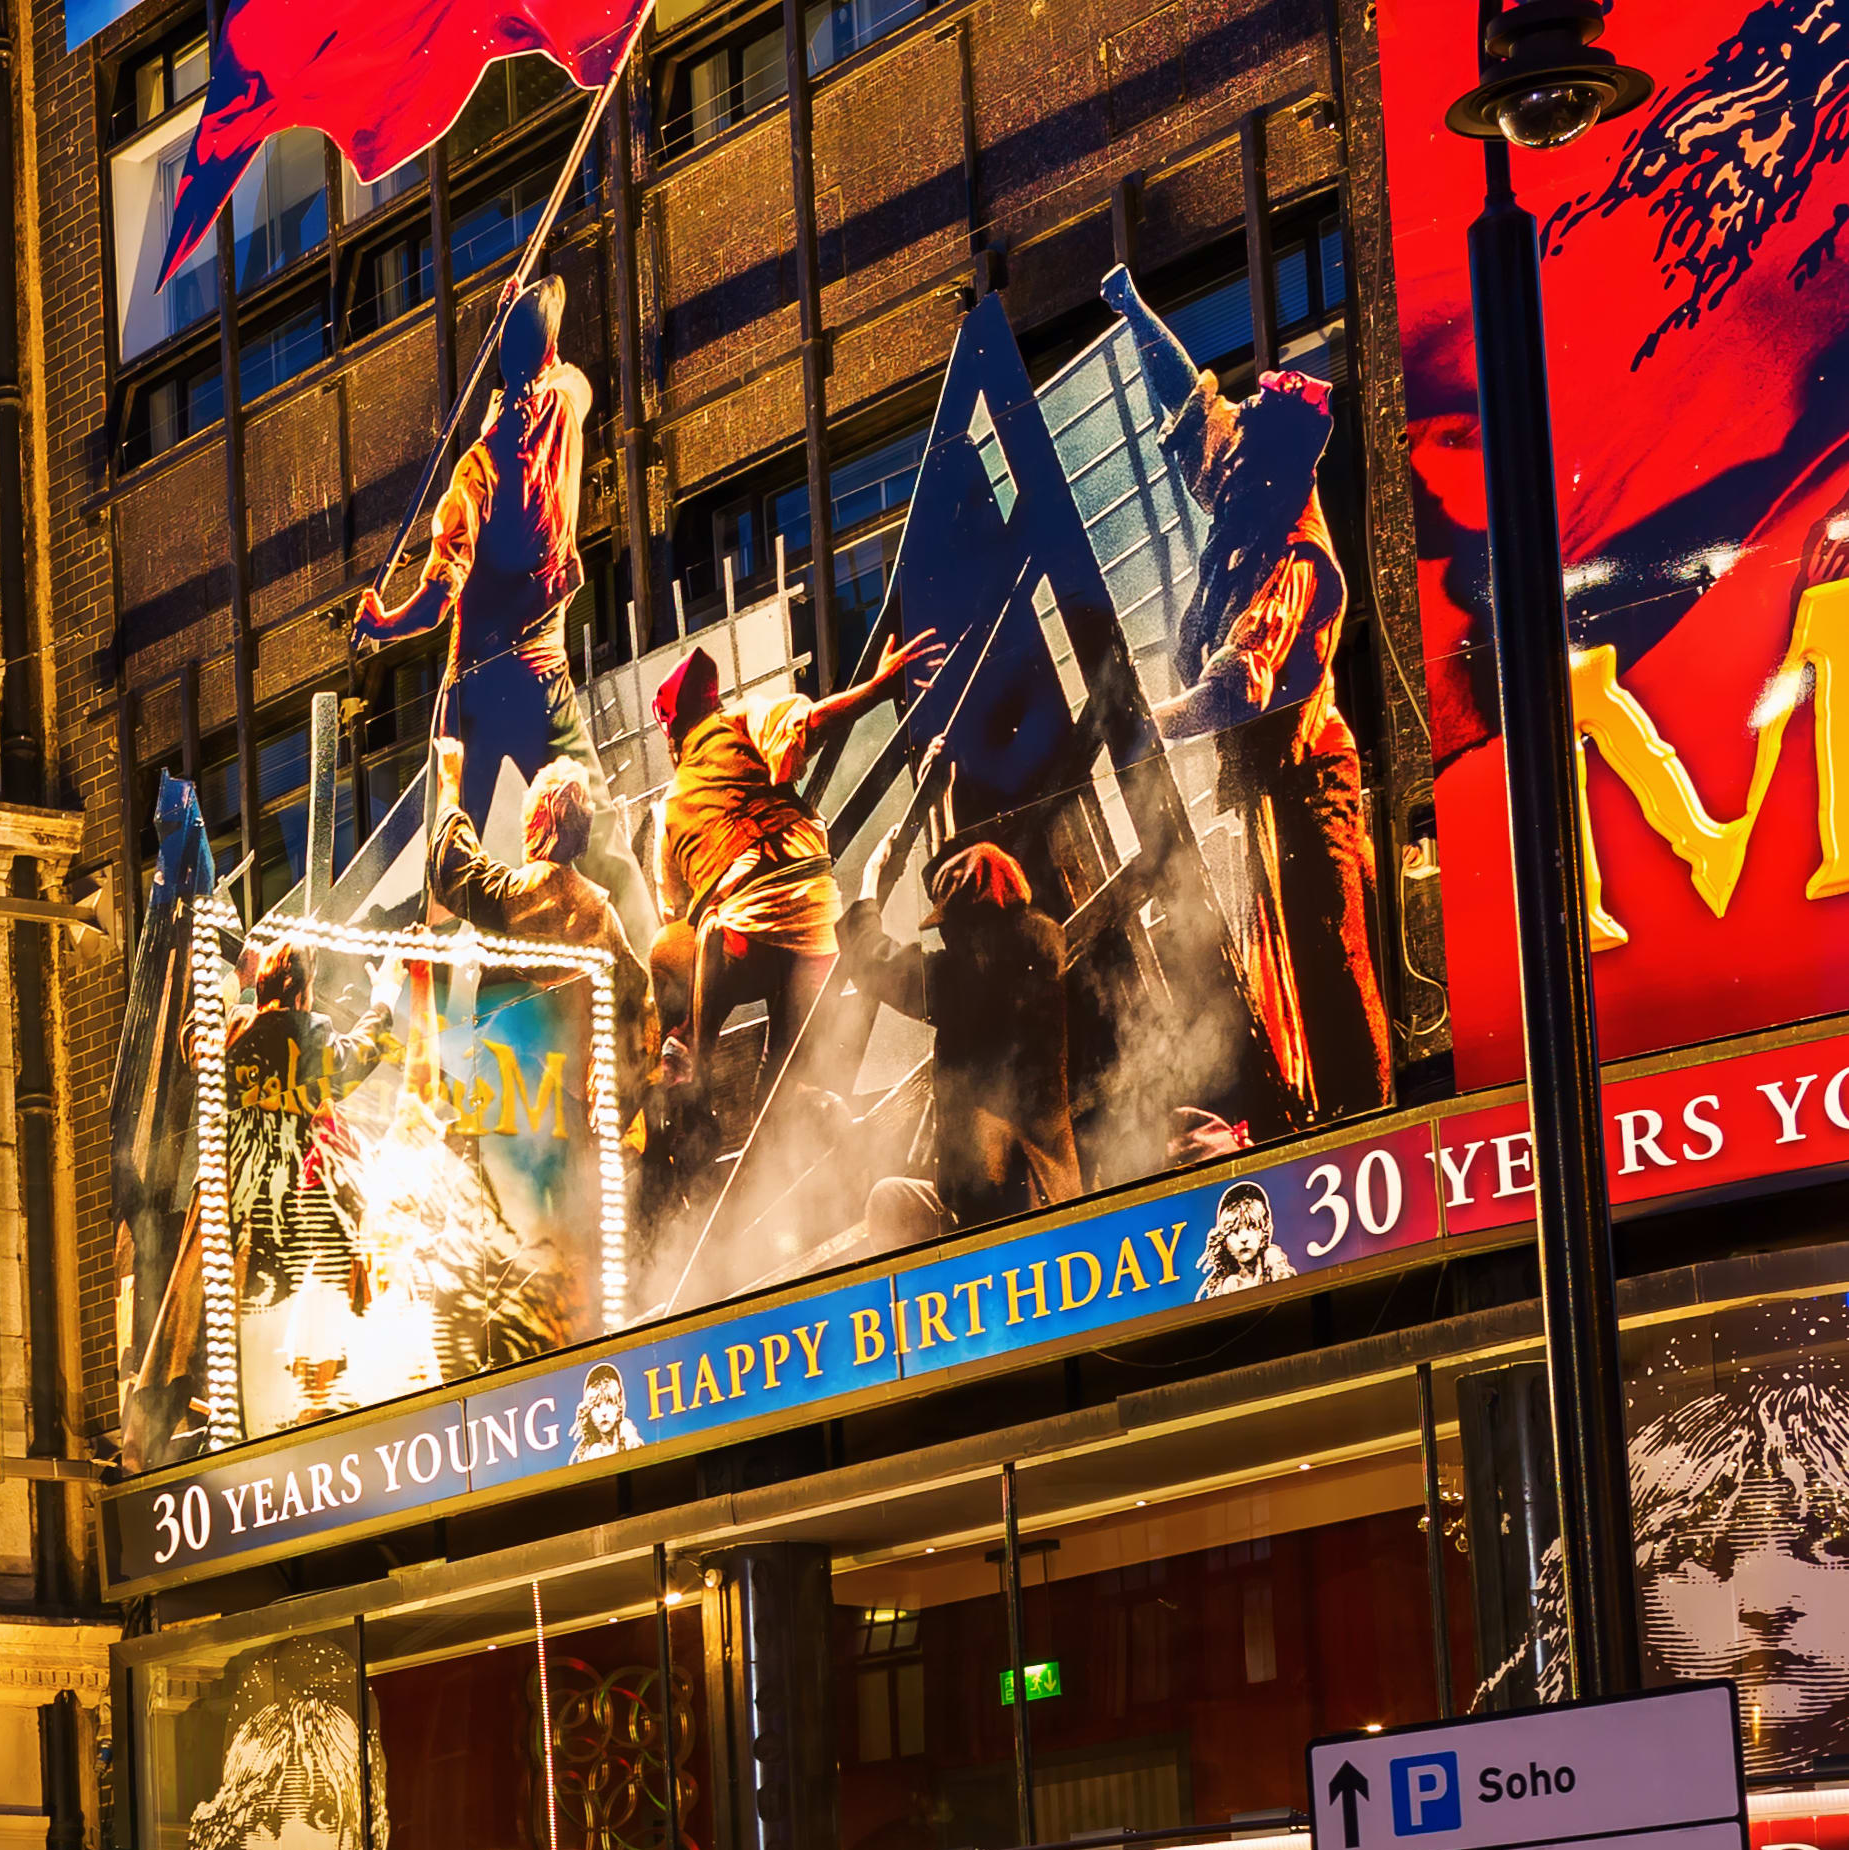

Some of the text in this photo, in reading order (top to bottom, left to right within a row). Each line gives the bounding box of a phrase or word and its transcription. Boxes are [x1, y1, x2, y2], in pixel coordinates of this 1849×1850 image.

[153, 1485, 211, 1564] 30
[221, 1454, 362, 1534] YEARS
[375, 1396, 560, 1493] YOUNG
[644, 1320, 828, 1421] HAPPY
[852, 1221, 1188, 1367] BIRTHDAY
[1305, 1149, 1404, 1259] 30
[1425, 1094, 1724, 1208] YERS
[1478, 1761, 1577, 1804] Soho
